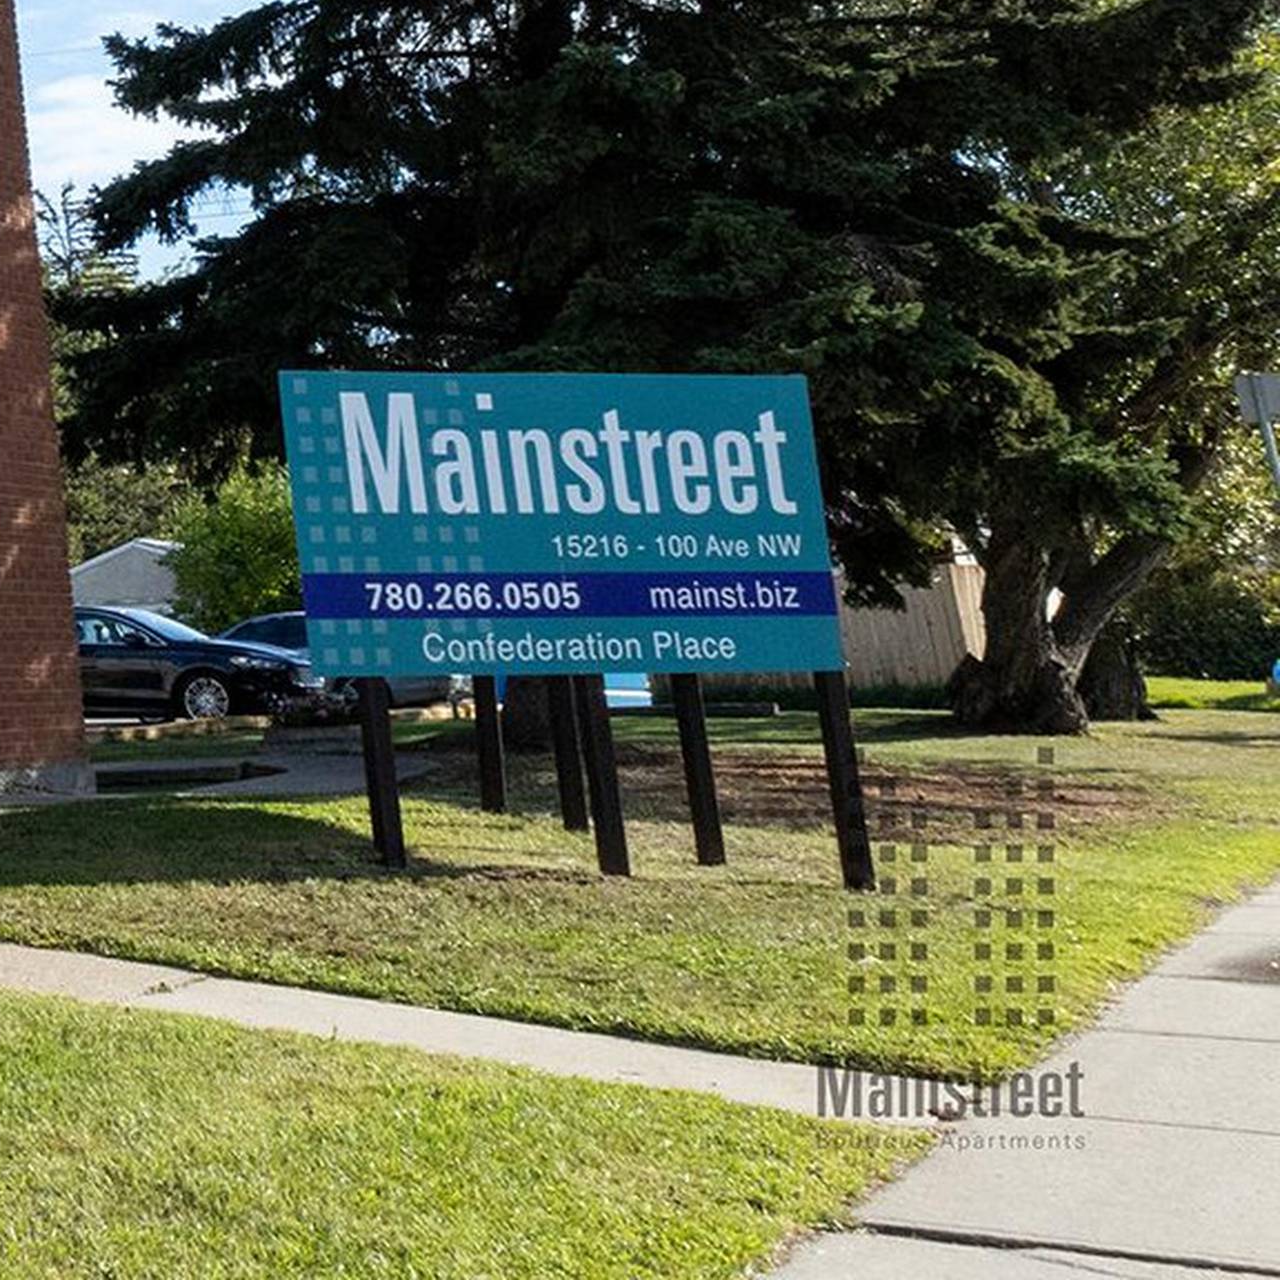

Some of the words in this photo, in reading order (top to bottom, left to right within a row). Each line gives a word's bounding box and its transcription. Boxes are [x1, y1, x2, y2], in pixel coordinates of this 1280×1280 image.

[339, 392, 797, 515] Mainstreet
[552, 533, 629, 558] 15216
[655, 534, 698, 558] 100
[705, 534, 750, 558] Ave
[758, 534, 802, 557] NW
[365, 581, 581, 611] 780.266.0505
[649, 580, 800, 610] mainst.biz
[422, 631, 642, 662] Confederation
[653, 631, 737, 660] Place
